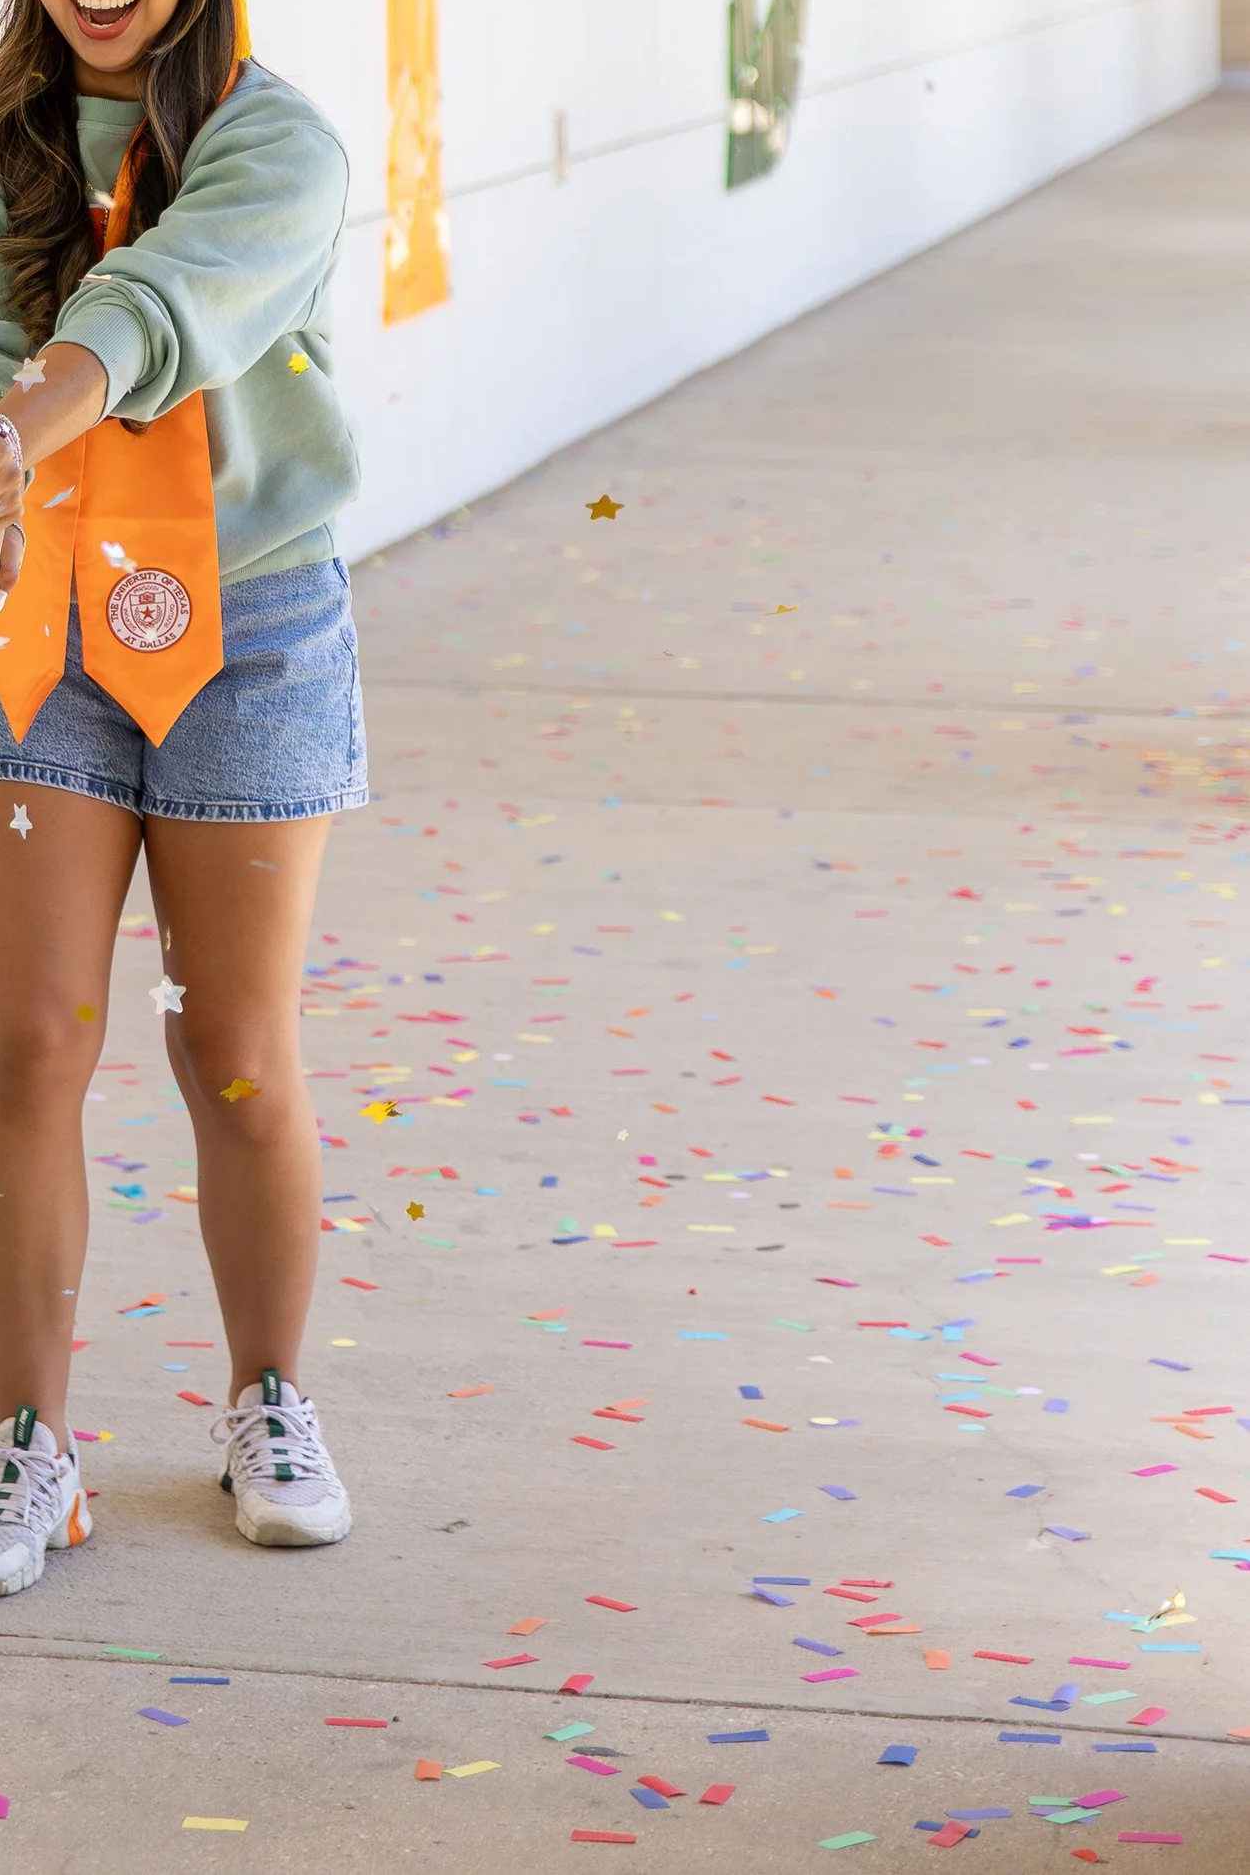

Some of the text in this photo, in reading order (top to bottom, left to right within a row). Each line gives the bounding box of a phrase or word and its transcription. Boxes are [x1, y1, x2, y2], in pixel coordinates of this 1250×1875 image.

[114, 572, 160, 601] UNIVERSITY
[161, 576, 174, 586] OF
[173, 585, 189, 615] TEXAS
[110, 603, 119, 623] THE
[123, 632, 177, 648] AT DALLAS
